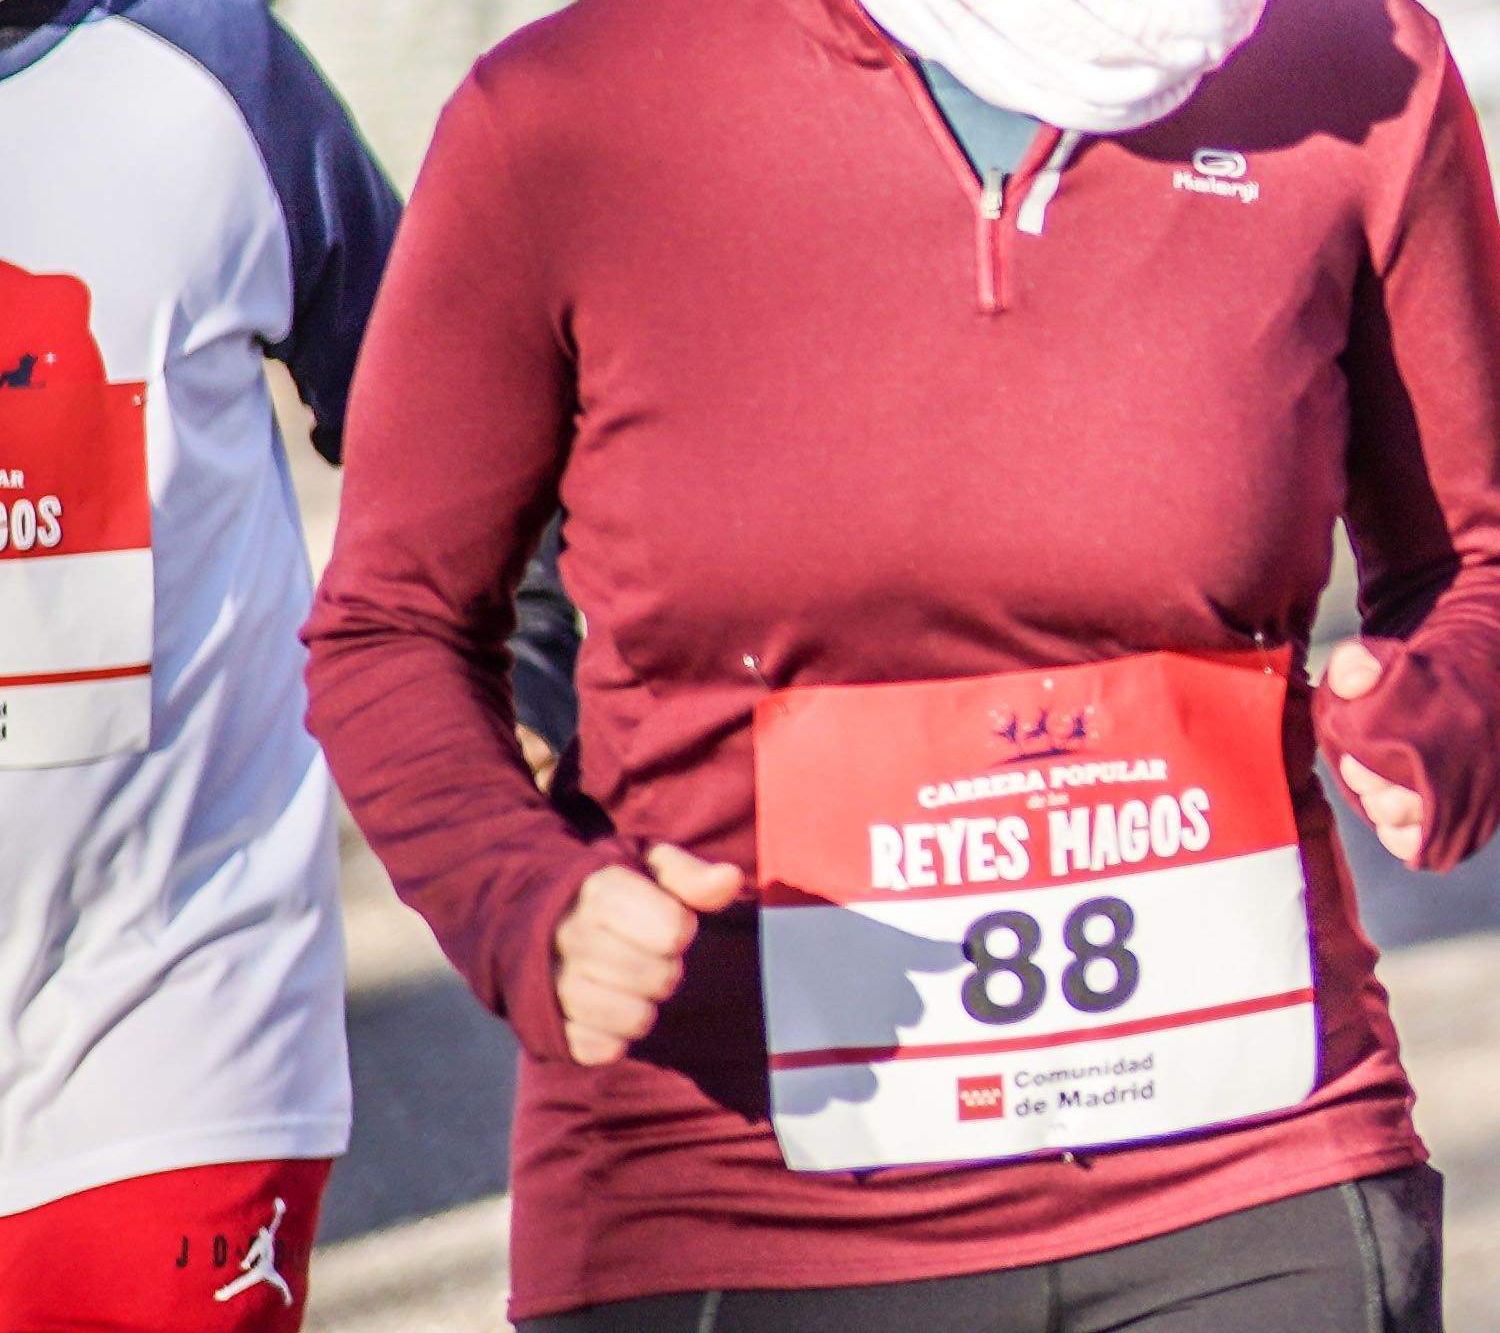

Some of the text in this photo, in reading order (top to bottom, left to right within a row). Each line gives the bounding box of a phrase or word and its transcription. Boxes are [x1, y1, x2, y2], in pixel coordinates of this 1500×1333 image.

[918, 758, 1168, 809] CARRERA POPULAR
[869, 787, 1211, 892] REYES MAGOS
[961, 895, 1140, 1025] 88
[1014, 1052, 1154, 1089] Comunidad
[1015, 1080, 1155, 1118] de Madrid
